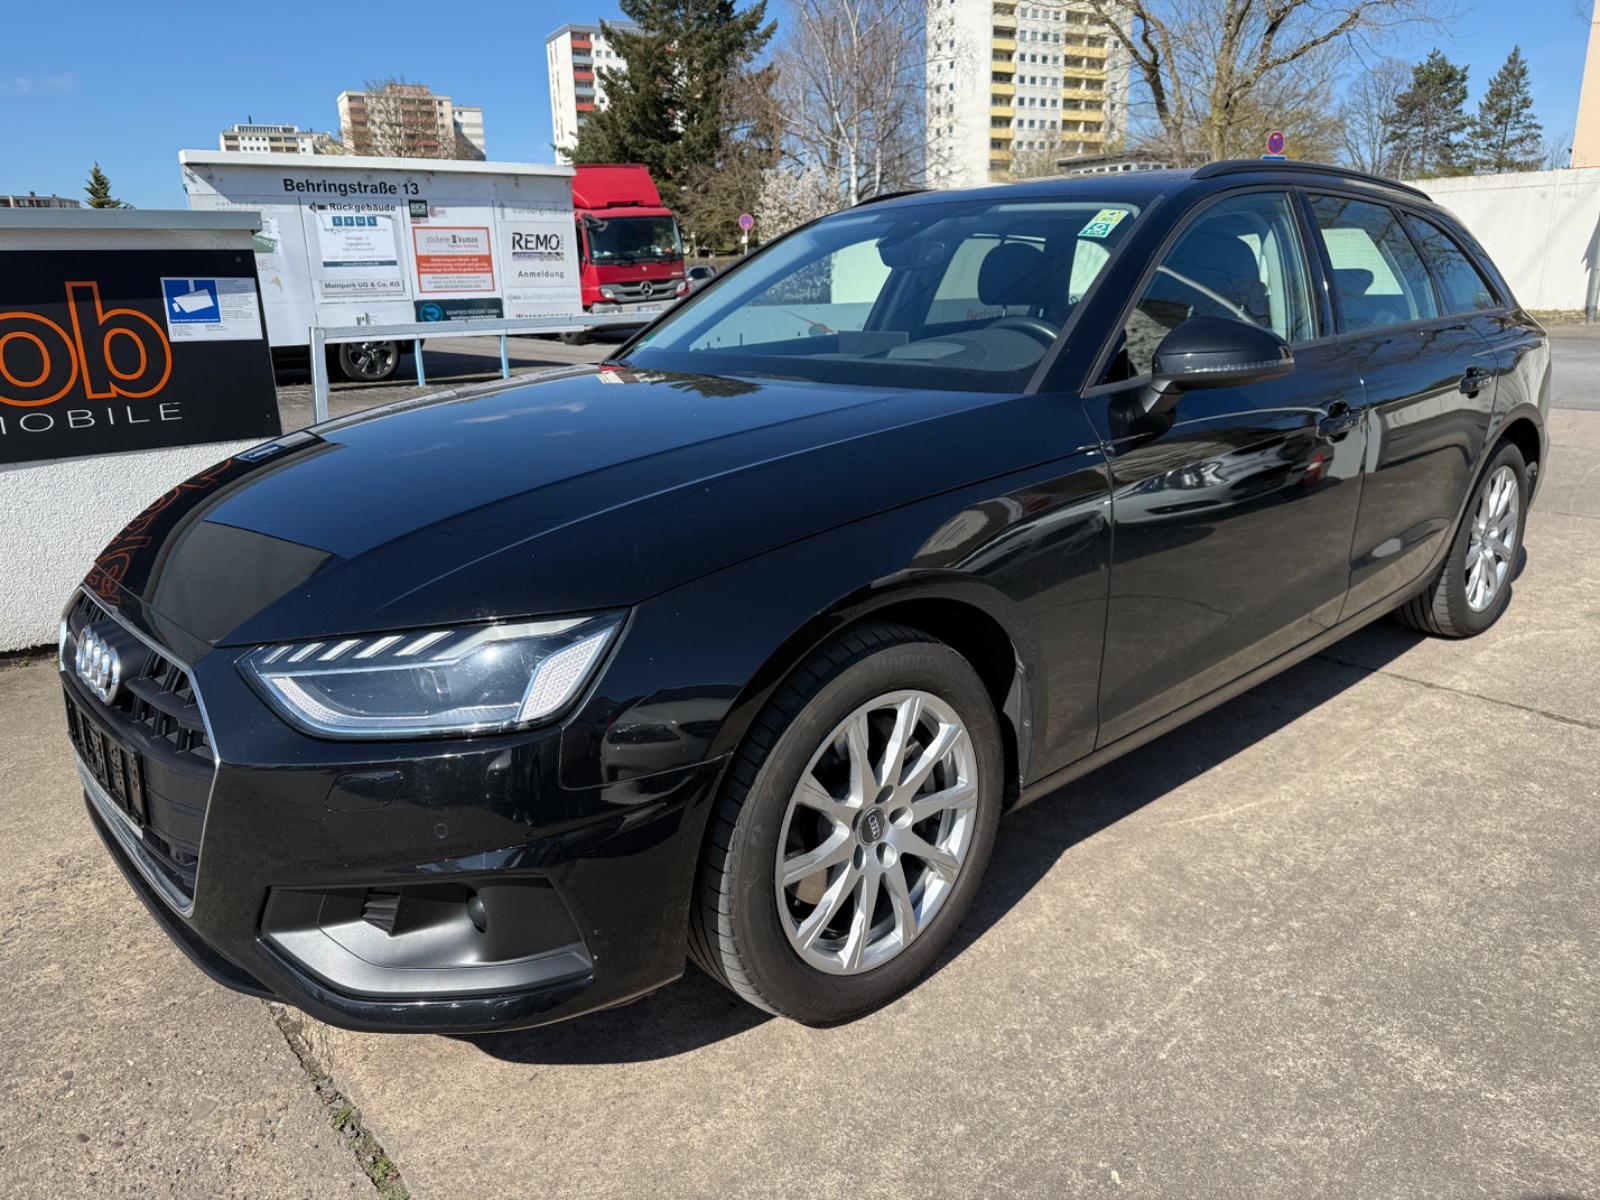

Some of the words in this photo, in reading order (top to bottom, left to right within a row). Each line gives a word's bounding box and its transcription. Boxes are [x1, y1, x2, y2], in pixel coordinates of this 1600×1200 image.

[282, 178, 397, 197] Behringstraße
[402, 182, 420, 195] 13
[329, 202, 396, 213] Rückgebäude
[512, 232, 560, 250] REMO
[518, 270, 565, 279] Anmeldung
[324, 282, 356, 290] Mainpark
